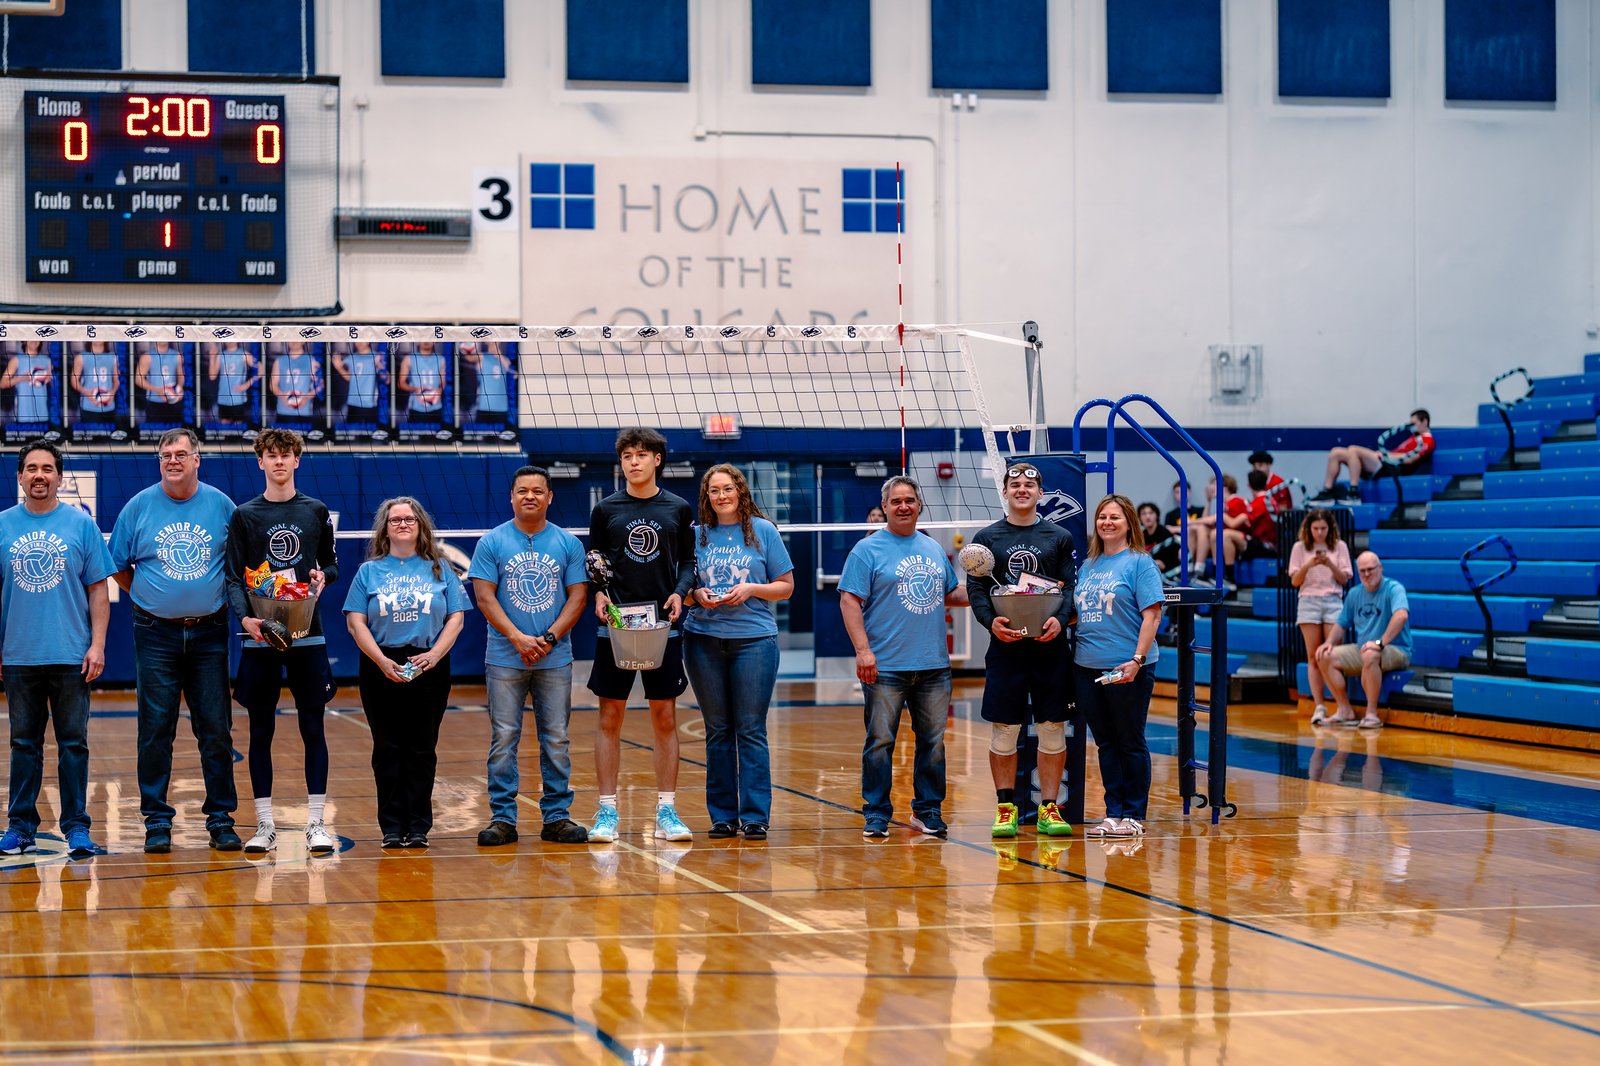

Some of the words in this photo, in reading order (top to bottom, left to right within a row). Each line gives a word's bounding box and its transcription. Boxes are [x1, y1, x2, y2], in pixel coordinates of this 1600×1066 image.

[38, 97, 81, 116] Home
[225, 100, 279, 120] Guests
[127, 97, 210, 137] 2:00
[65, 122, 87, 160] 0
[257, 125, 280, 164] 0
[133, 162, 180, 184] period
[35, 191, 71, 210] fouls
[132, 191, 182, 213] player
[241, 193, 277, 212] fouls
[479, 177, 513, 221] 3
[618, 184, 821, 236] HOME
[165, 222, 171, 248] 1
[39, 260, 69, 274] won
[138, 260, 177, 278] game
[245, 261, 275, 275] won
[639, 255, 692, 287] OF
[705, 256, 792, 289] THE
[566, 306, 871, 356] COUGARS
[155, 522, 190, 543] SENIOR
[193, 525, 212, 543] DAD
[266, 523, 287, 536] FINAL
[290, 523, 303, 535] SET
[625, 518, 646, 531] FINAL
[649, 520, 662, 531] SET
[9, 531, 46, 553] SENIOR
[48, 533, 68, 552] DAD
[705, 543, 742, 555] Senior
[1006, 544, 1026, 555] FINAL
[1028, 545, 1042, 555] SET
[157, 550, 168, 559] 20
[201, 549, 211, 559] 25
[505, 551, 539, 572] SENIOR
[542, 554, 560, 573] DAD
[12, 560, 21, 570] 20
[54, 560, 65, 569] 25
[162, 564, 182, 580] FINISH
[185, 564, 208, 581] STRONG
[895, 555, 923, 577] SENIOR
[926, 557, 943, 574] DAD
[386, 572, 423, 584] Senior
[1087, 569, 1113, 580] Senior
[14, 576, 35, 593] FINISH
[37, 575, 62, 593] STRONG
[377, 582, 432, 596] Volleyball
[507, 581, 517, 589] 20
[549, 580, 558, 589] 25
[898, 585, 908, 594] 20
[510, 595, 530, 613] FINISH
[901, 598, 922, 614] FINISH
[393, 611, 419, 623] 2025
[1081, 611, 1102, 623] 2025
[632, 661, 655, 670] Emilio
